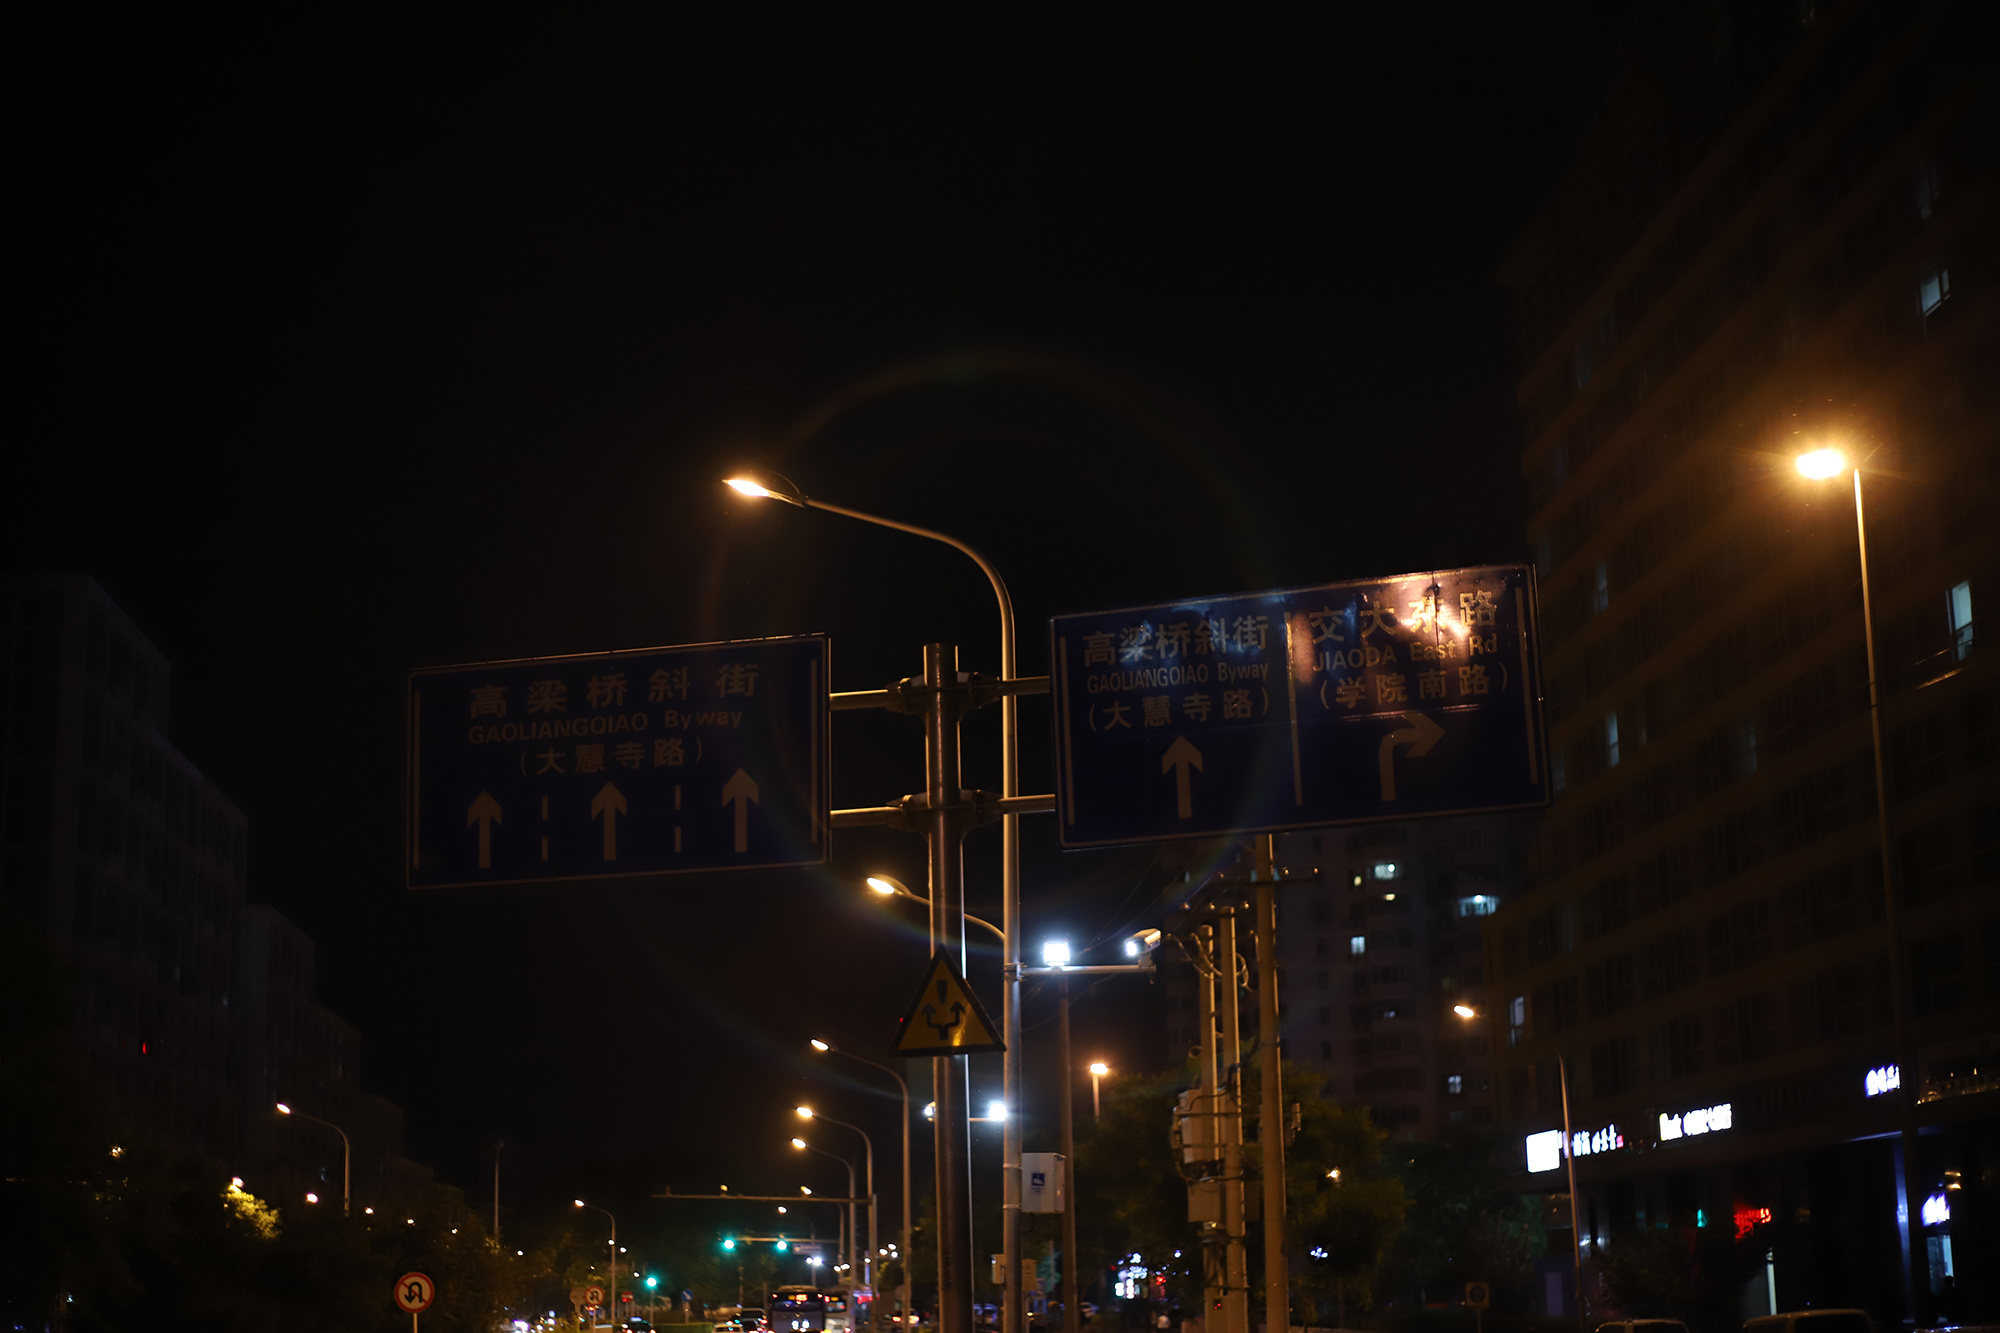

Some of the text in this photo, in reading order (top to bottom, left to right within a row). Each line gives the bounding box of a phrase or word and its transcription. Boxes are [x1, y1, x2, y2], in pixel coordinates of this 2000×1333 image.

[1082, 615, 1269, 669] 高梁桥斜街
[1312, 633, 1498, 673] JIAODA East Rd
[469, 662, 759, 720] 高梁桥斜街
[1086, 661, 1269, 695] GAOLIANGQIAO Byway
[467, 708, 743, 745] GAOLIANGQIAO Byway
